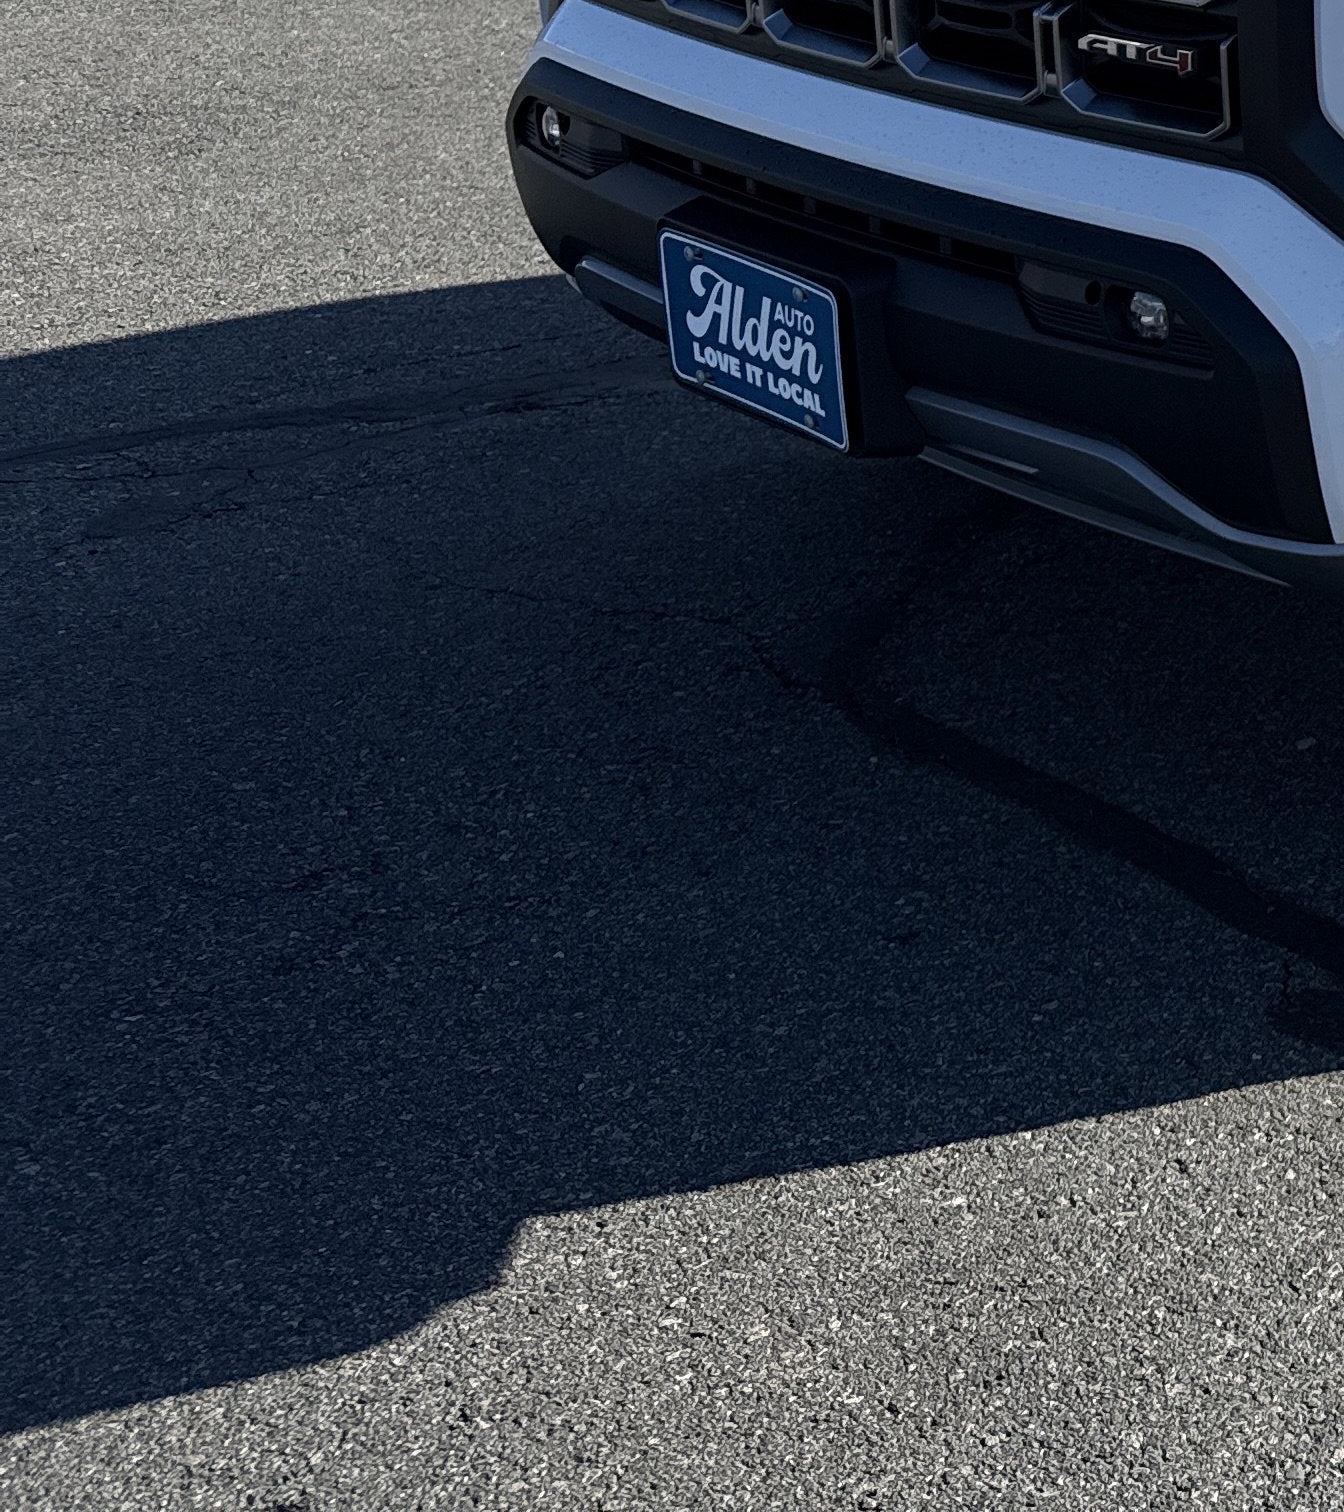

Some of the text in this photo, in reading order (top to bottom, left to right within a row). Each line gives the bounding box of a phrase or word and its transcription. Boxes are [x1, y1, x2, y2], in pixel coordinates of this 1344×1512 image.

[1077, 33, 1194, 79] AT4
[685, 264, 824, 385] Alden
[774, 302, 815, 336] AUTO
[693, 341, 826, 418] LOVE IT LOCAL
